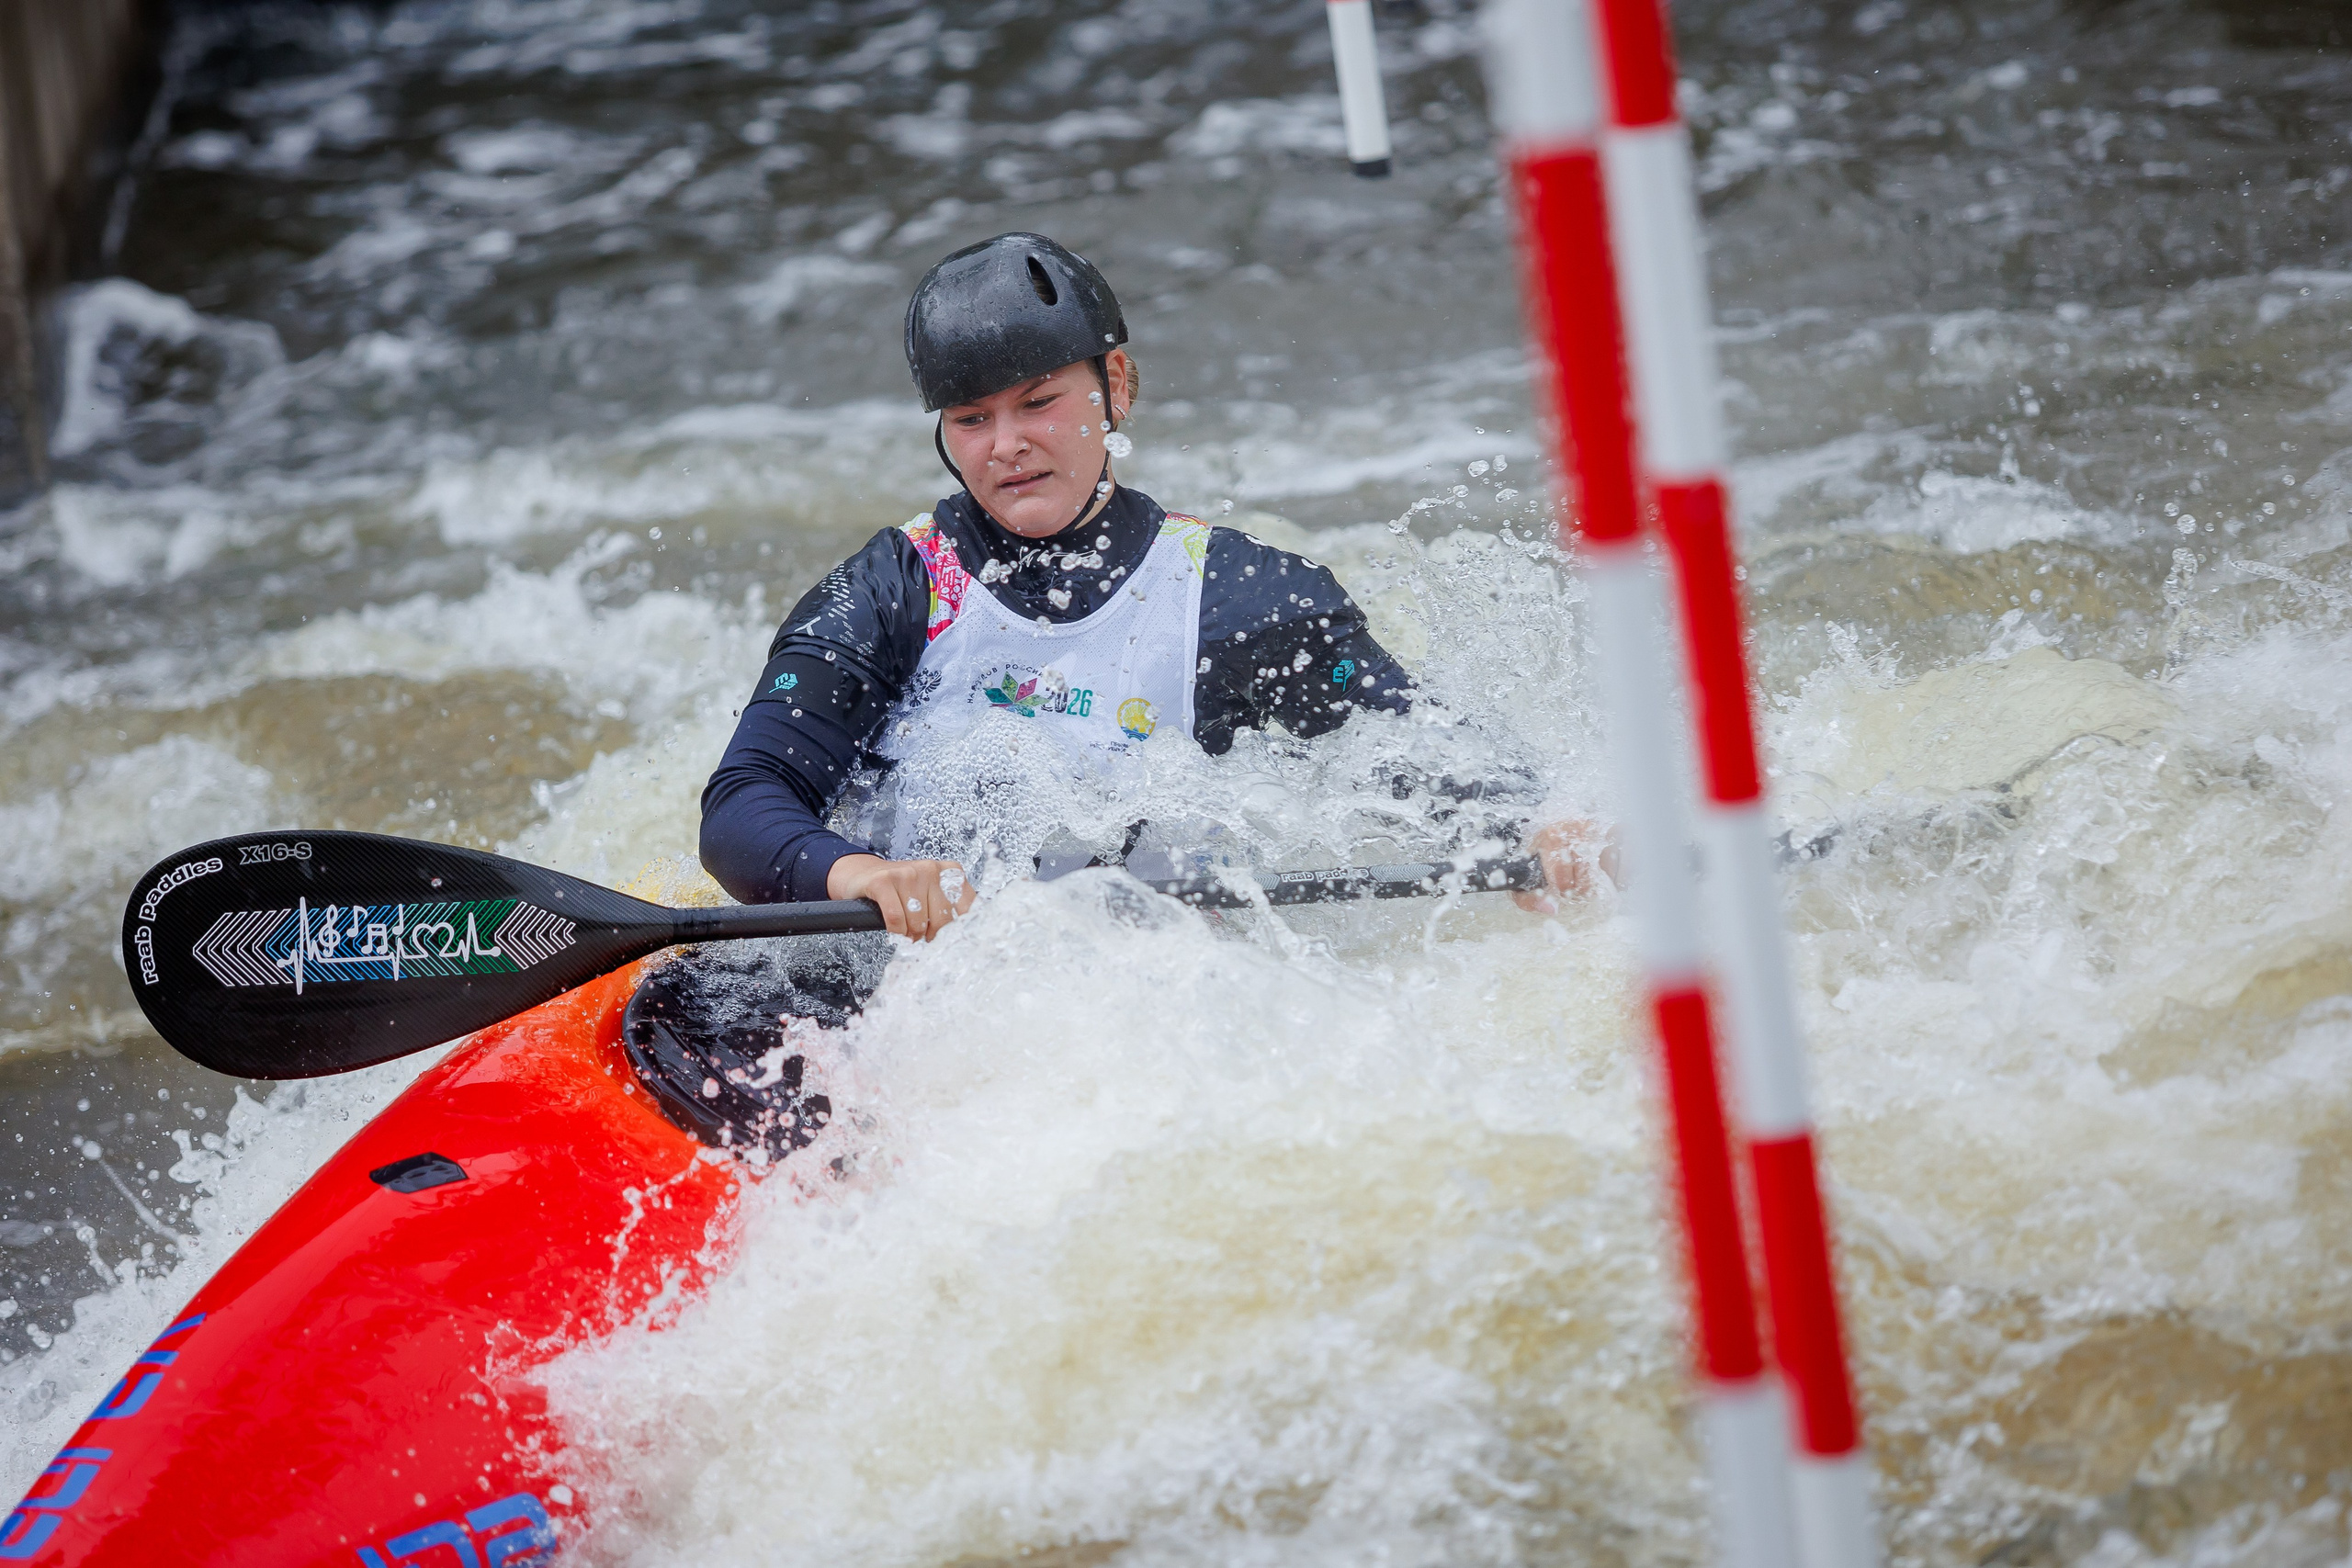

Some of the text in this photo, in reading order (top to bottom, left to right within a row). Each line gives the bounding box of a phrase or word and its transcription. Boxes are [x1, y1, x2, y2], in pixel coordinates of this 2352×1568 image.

[1040, 686, 1093, 717] 2026
[238, 841, 313, 865] X16-S
[1280, 871, 1315, 883] raab
[134, 857, 223, 986] raab paddles
